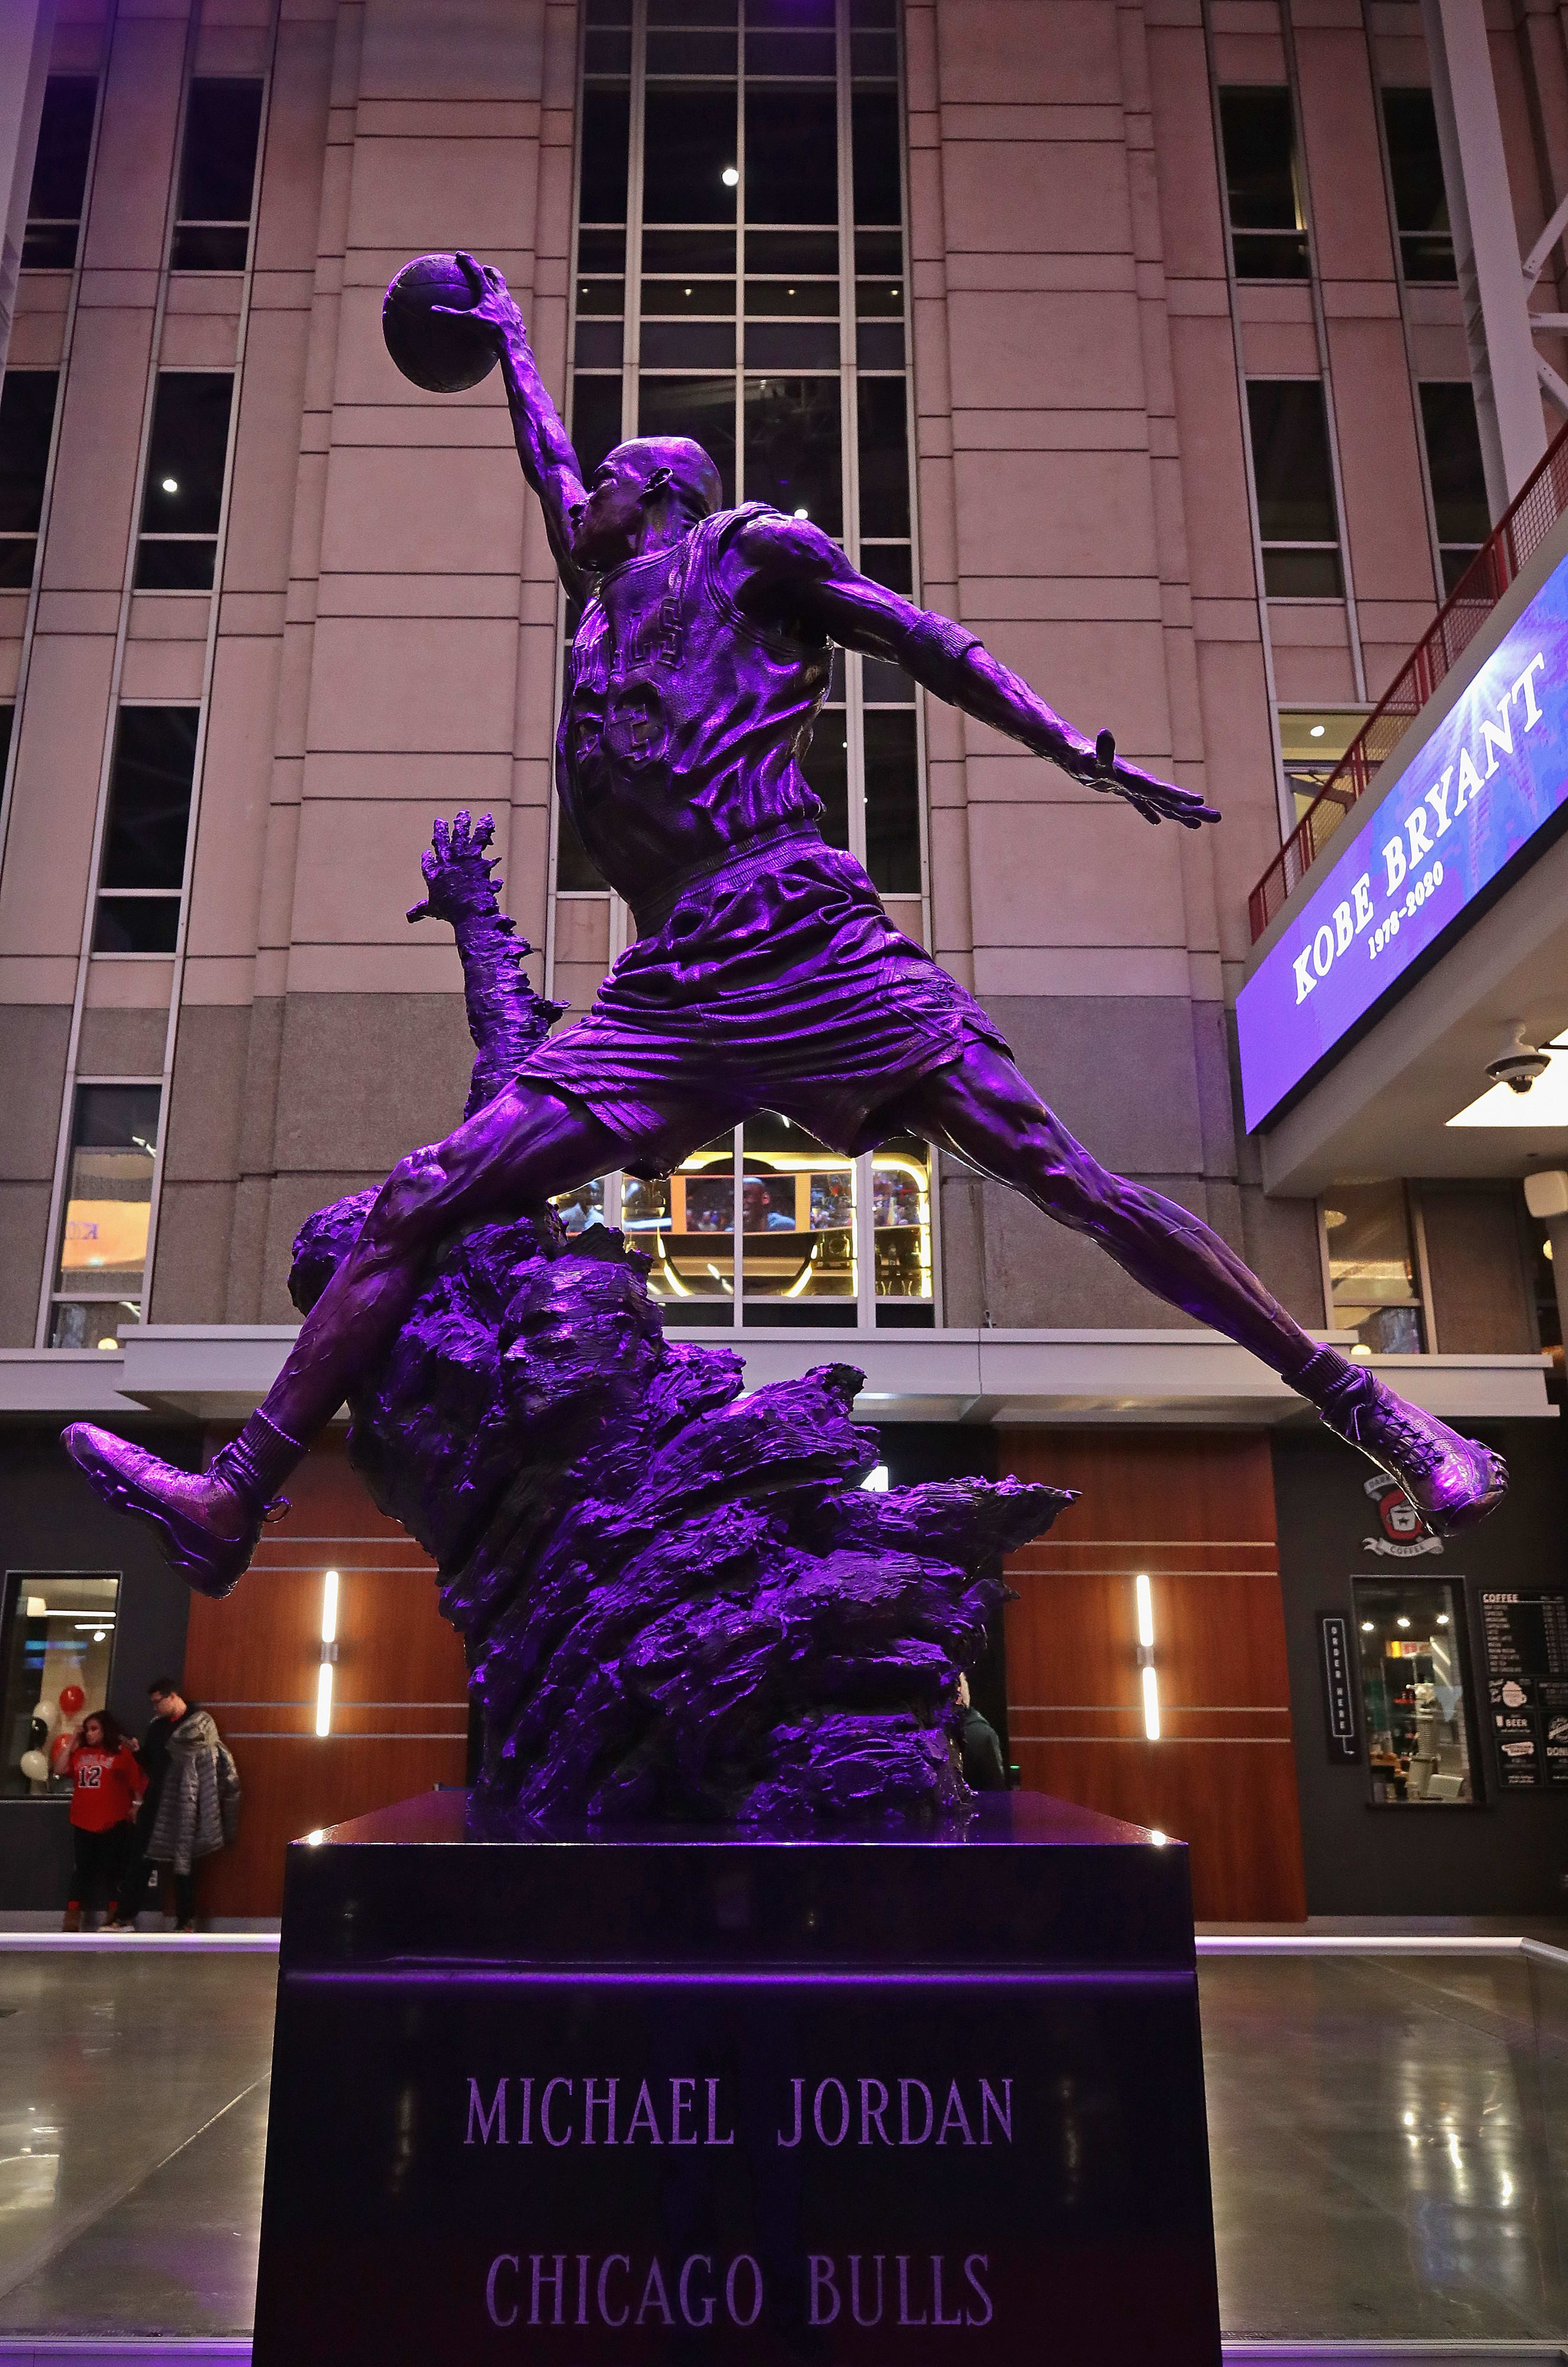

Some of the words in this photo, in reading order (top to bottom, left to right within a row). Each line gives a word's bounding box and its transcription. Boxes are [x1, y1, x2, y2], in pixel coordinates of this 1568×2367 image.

[1292, 872, 1374, 1005] KOBE
[1382, 652, 1544, 897] BRYANT
[1368, 860, 1444, 960] 1978-2020
[1390, 1544, 1425, 1555] COFFEE
[1482, 1594, 1519, 1603] COFFEE
[1331, 1626, 1341, 1679] ORDER
[1337, 1687, 1346, 1730] HERE
[1505, 1718, 1528, 1727] BEER
[78, 1765, 102, 1788] 12
[463, 2076, 734, 2147] MICHAEL
[777, 2076, 1014, 2147] JORDAN
[485, 2253, 764, 2327] CHICAGO
[806, 2253, 993, 2327] BULLS
